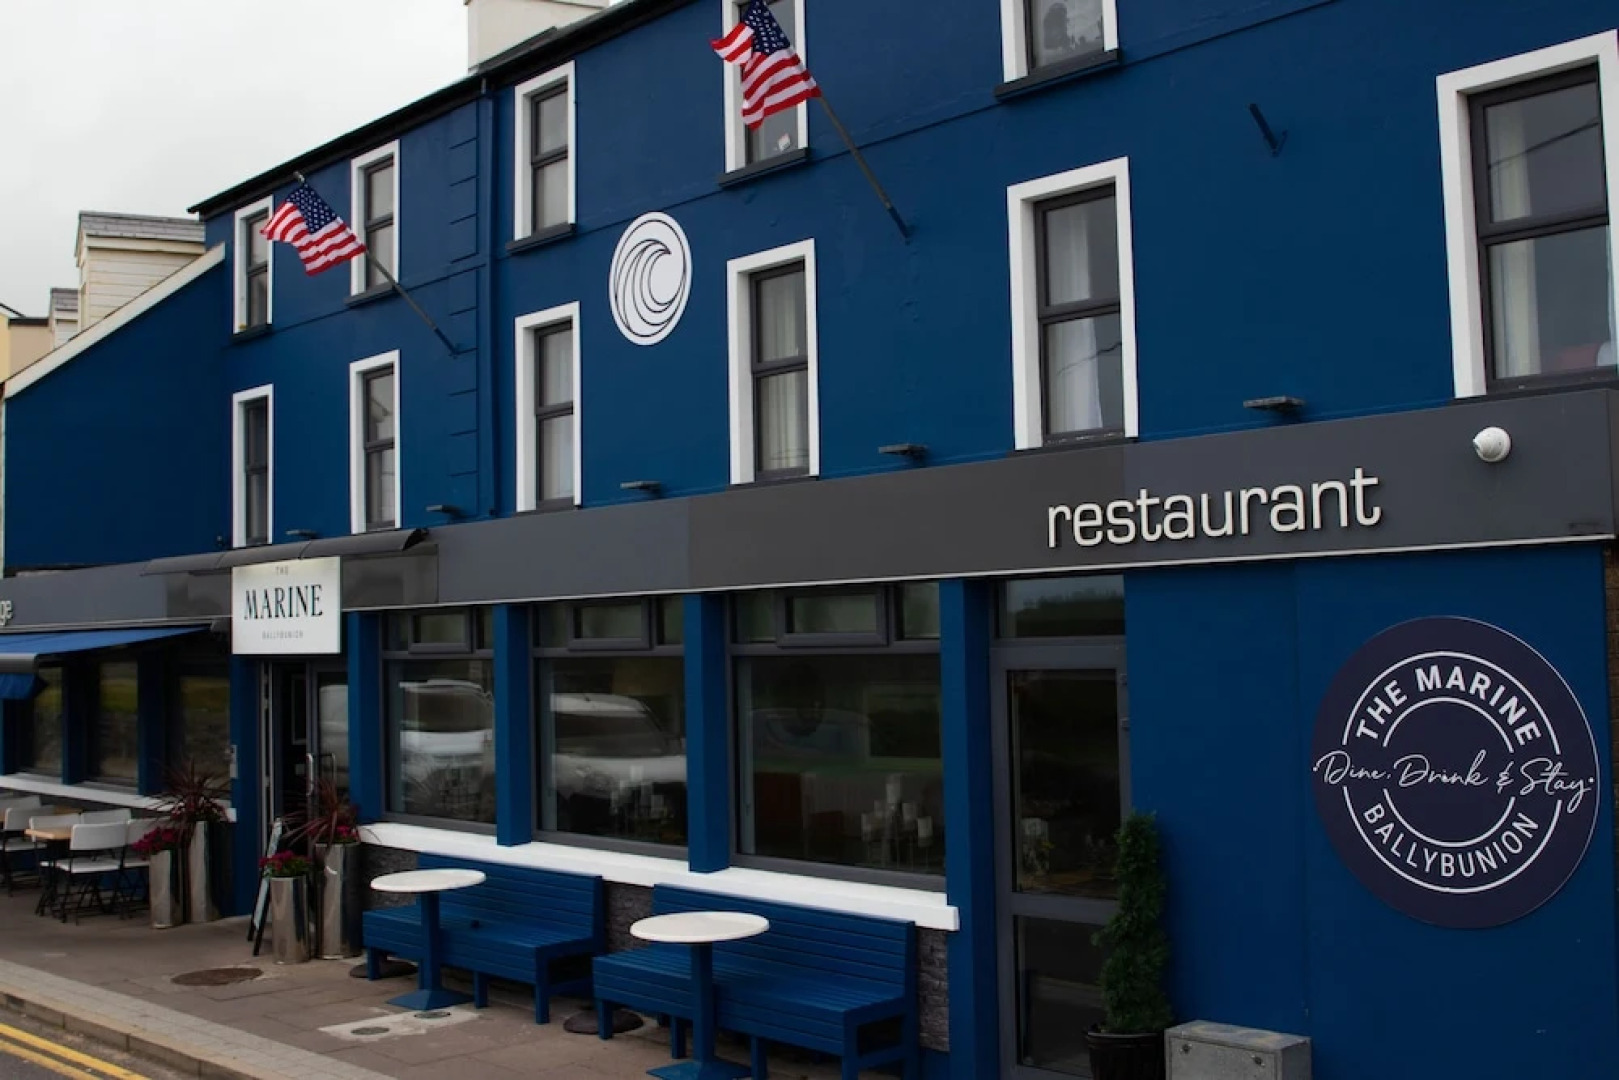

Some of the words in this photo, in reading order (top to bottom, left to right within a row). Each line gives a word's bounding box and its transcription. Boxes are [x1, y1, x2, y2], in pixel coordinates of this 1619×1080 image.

[1048, 467, 1382, 548] restaurant
[244, 584, 323, 620] MARINE
[1356, 679, 1408, 740] THE
[1414, 665, 1542, 746] MARINE
[1393, 749, 1489, 788] Drink
[1496, 761, 1514, 794] &
[1520, 757, 1591, 813] Stay
[1363, 803, 1539, 878] BALLYBUNION
